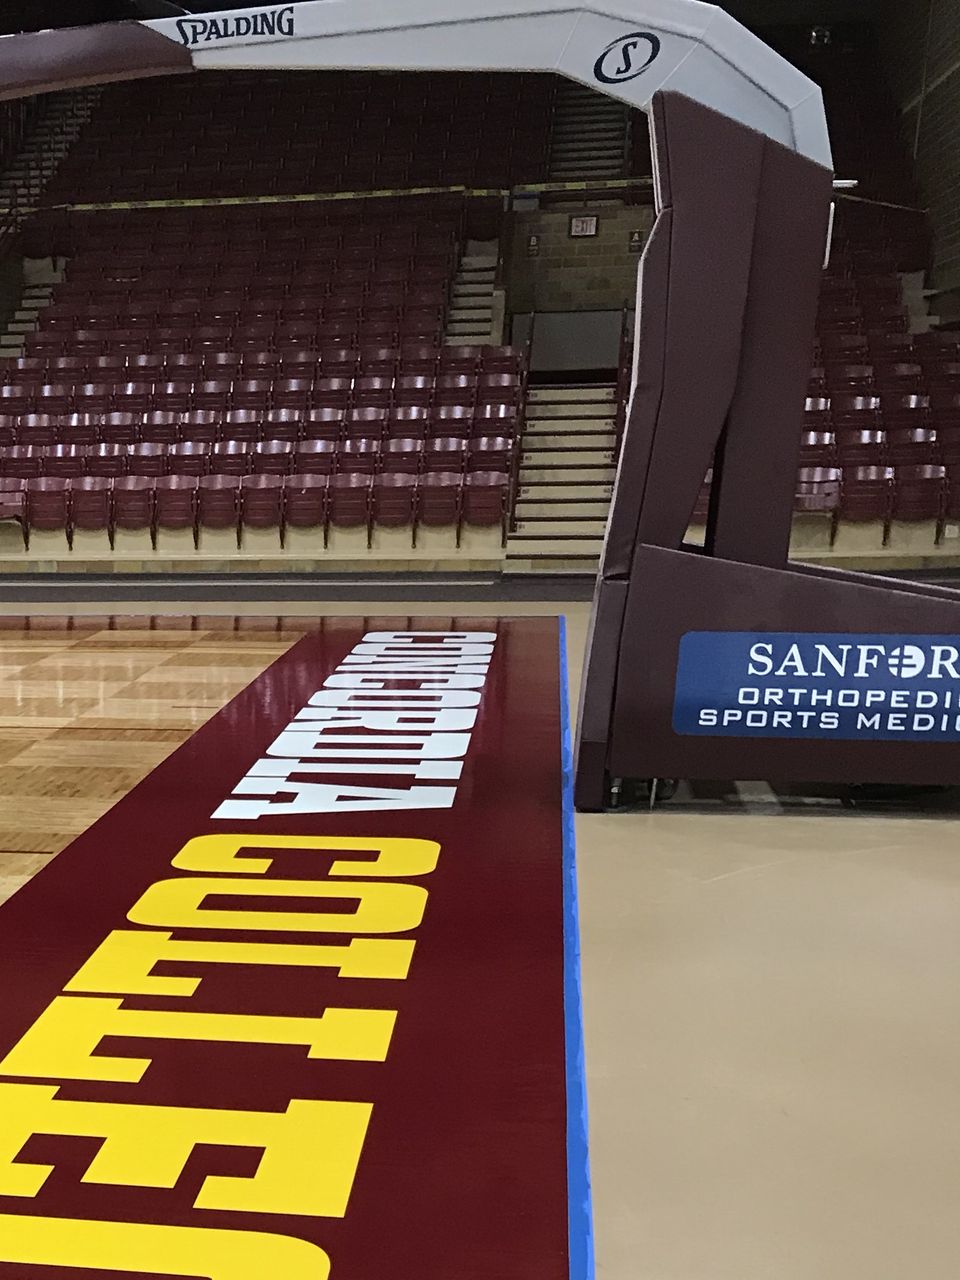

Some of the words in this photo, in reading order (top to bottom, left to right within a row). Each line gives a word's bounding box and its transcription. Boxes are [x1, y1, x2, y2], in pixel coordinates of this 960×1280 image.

[176, 6, 294, 46] SPALDING
[738, 687, 960, 709] ORTHOPEDI
[210, 631, 498, 820] CONCORDIA
[698, 708, 840, 729] SPORTS
[856, 712, 960, 731] MEDI
